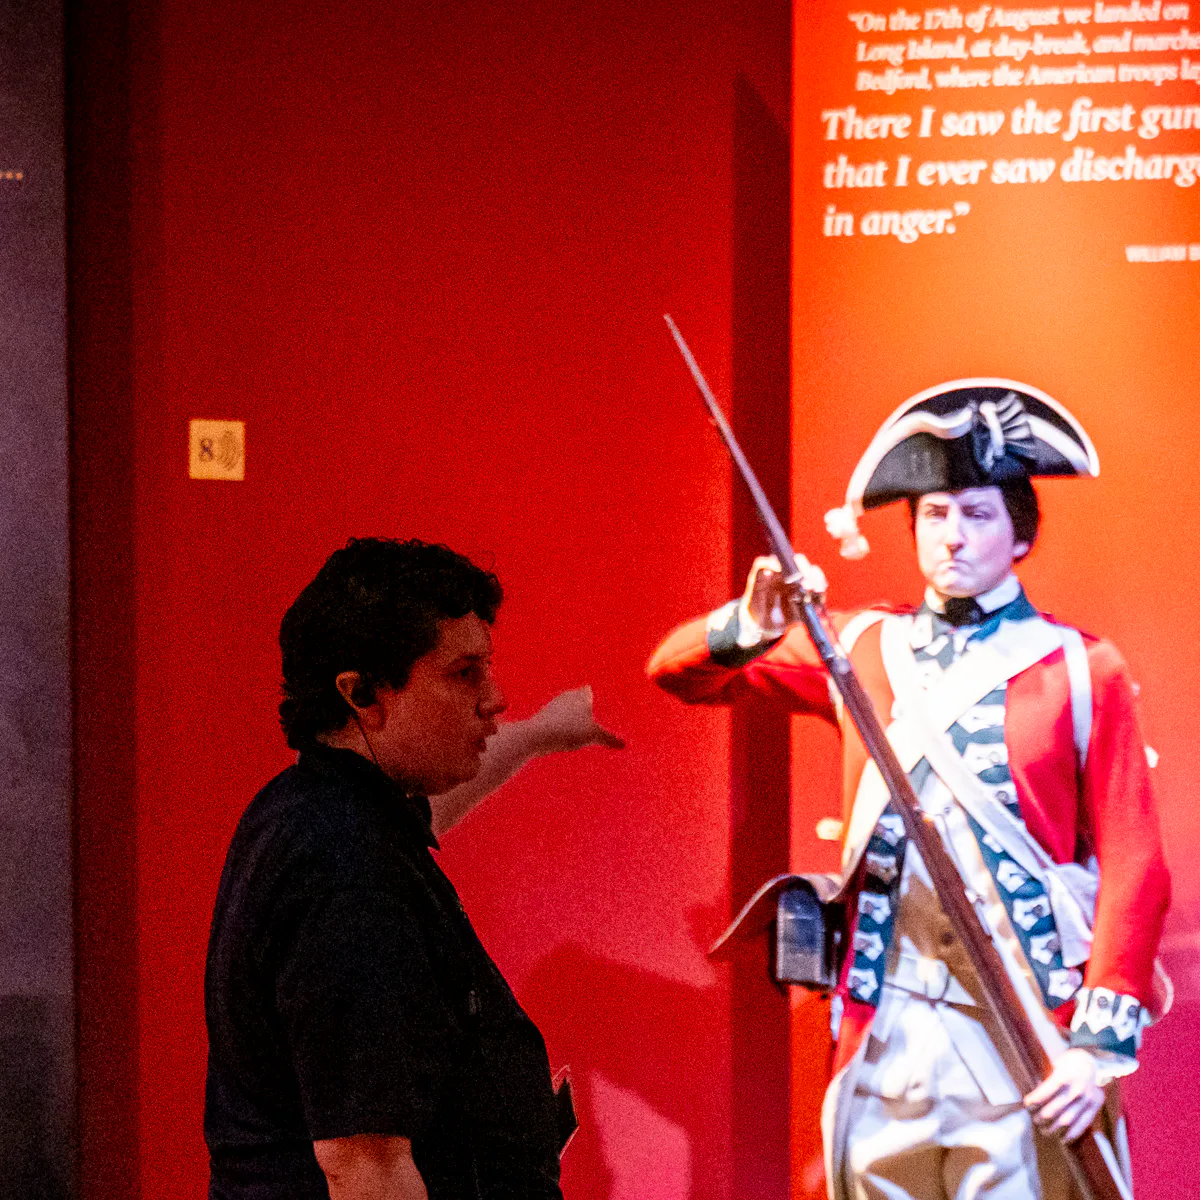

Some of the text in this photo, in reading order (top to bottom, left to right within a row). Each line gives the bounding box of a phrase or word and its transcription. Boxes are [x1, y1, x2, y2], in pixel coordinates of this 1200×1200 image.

[822, 104, 912, 141] There
[918, 104, 937, 138] I
[941, 109, 1006, 138] saw
[1010, 98, 1063, 135] the
[1061, 96, 1136, 142] first
[823, 153, 889, 189] that
[895, 153, 913, 187] I
[916, 159, 989, 187] ever
[991, 157, 1057, 184] saw
[823, 204, 855, 238] in
[199, 437, 215, 463] 8
